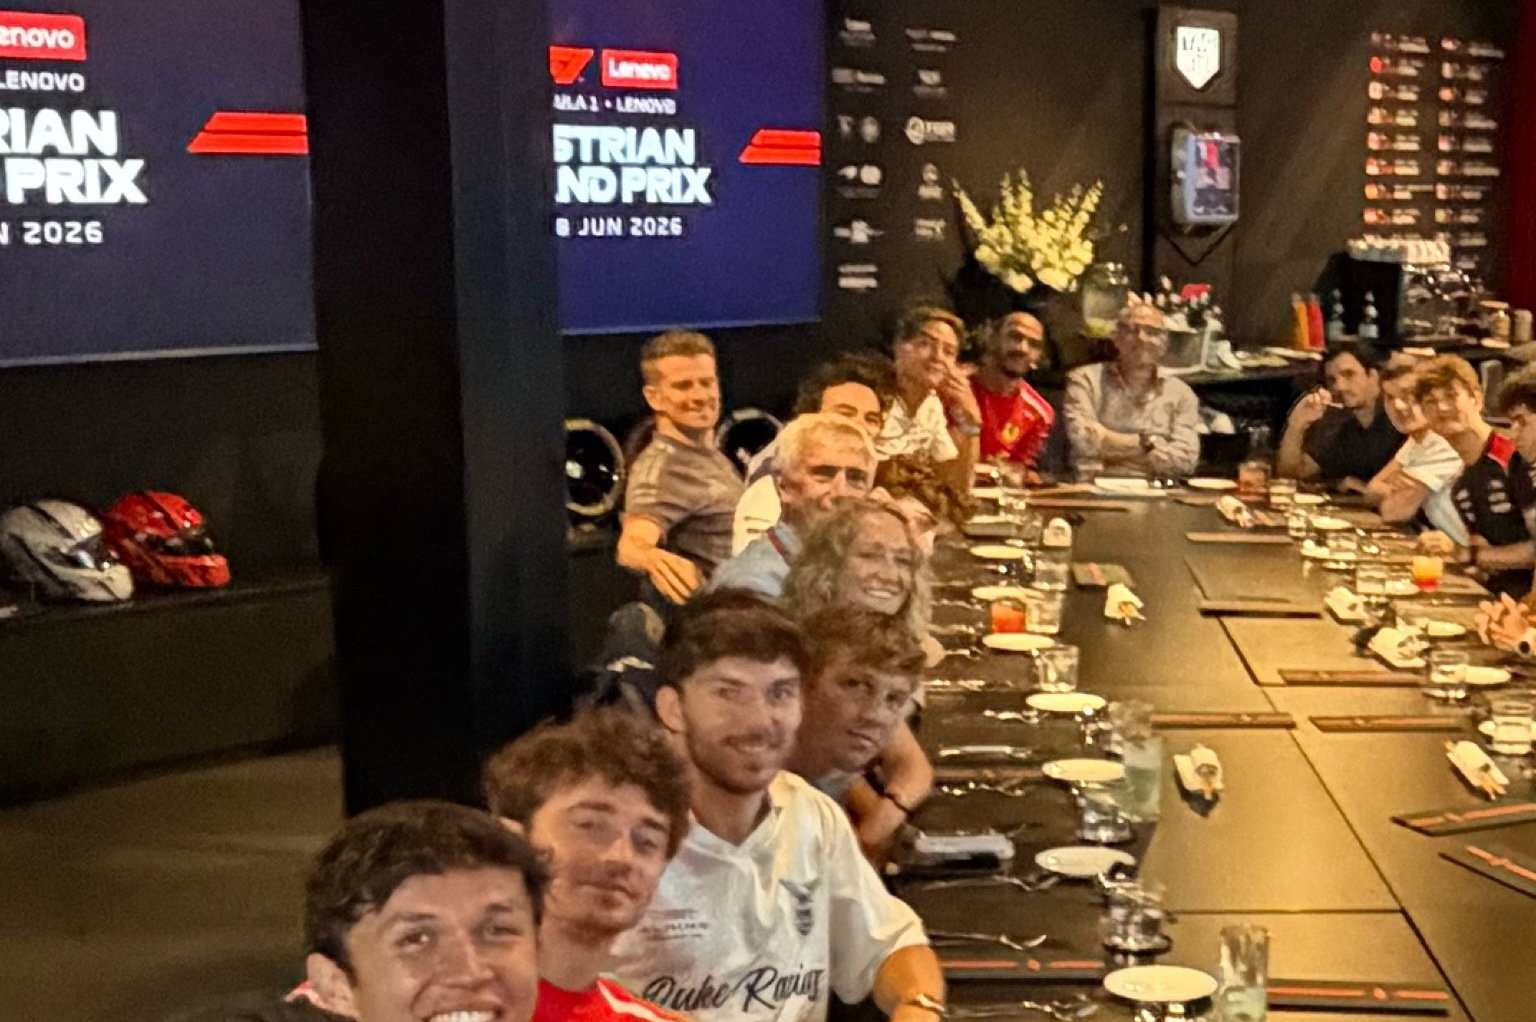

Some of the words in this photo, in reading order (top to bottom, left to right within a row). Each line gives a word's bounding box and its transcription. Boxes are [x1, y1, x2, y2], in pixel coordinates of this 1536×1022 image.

[608, 57, 672, 82] Lenovo
[615, 97, 677, 115] LENOVO
[0, 107, 118, 156] IAN
[4, 157, 149, 204] PRIX
[620, 166, 713, 204] PRIX
[22, 220, 104, 245] 2026
[577, 217, 623, 236] JUN
[629, 217, 683, 236] 2026
